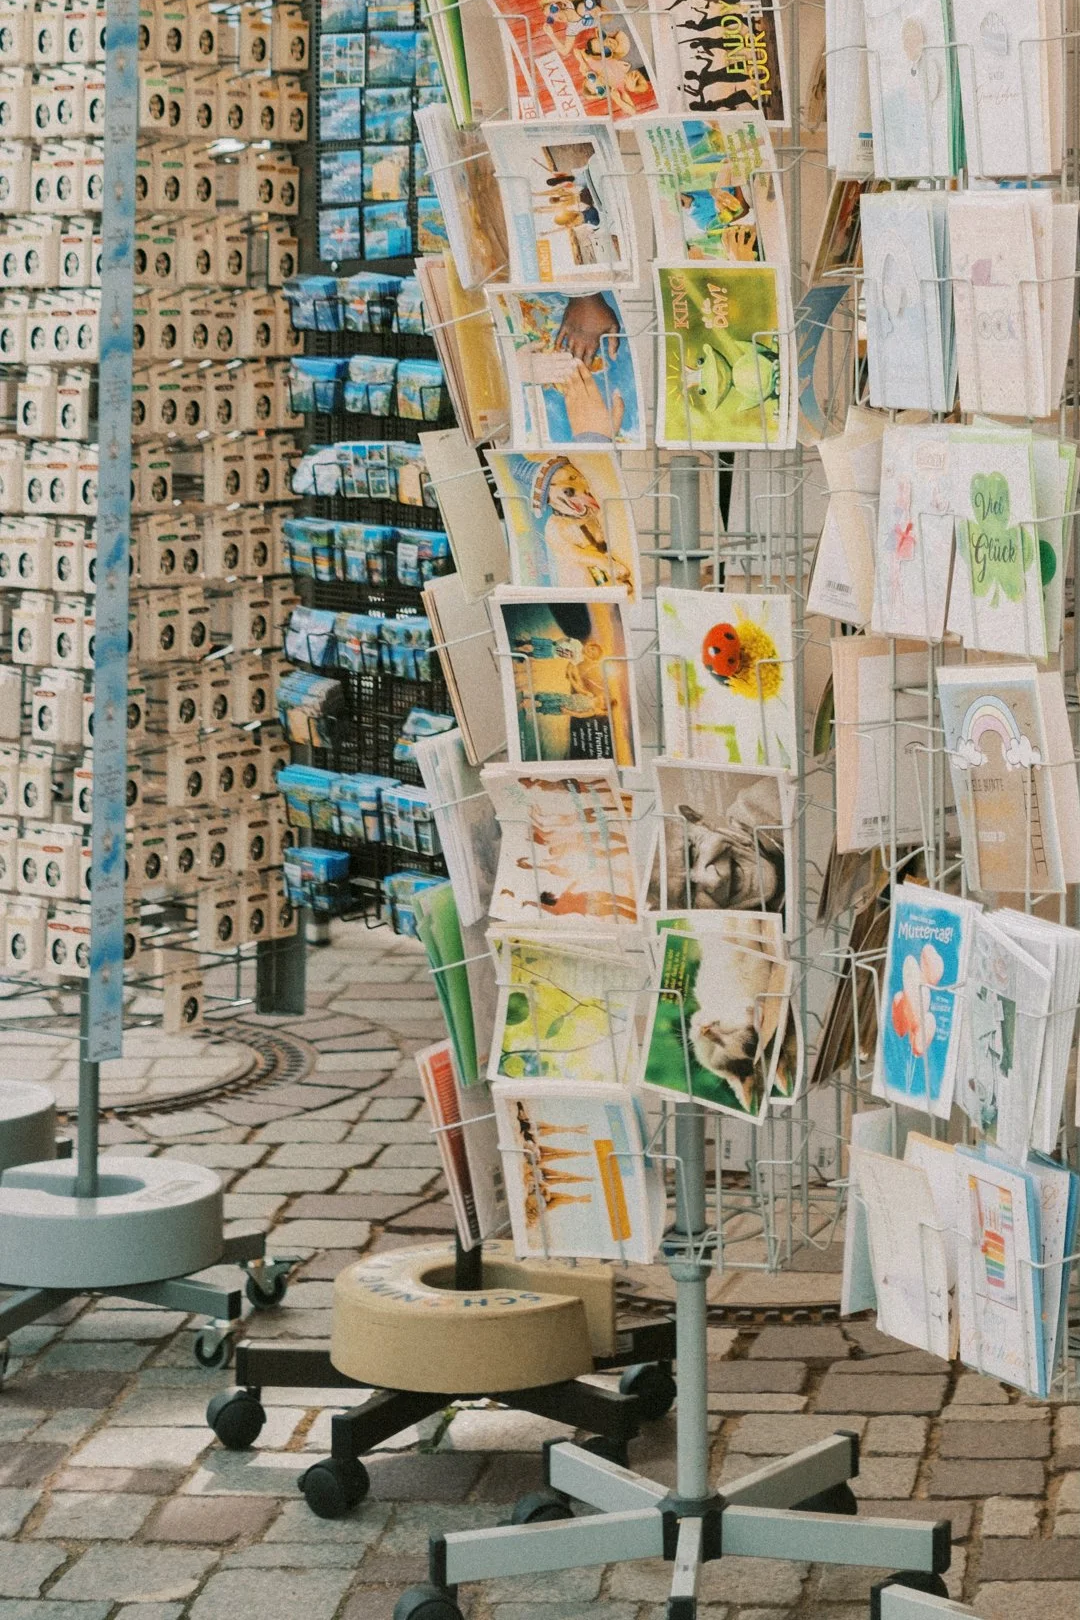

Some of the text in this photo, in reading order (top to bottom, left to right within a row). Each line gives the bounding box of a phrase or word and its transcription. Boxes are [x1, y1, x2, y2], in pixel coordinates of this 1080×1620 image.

[719, 0, 746, 75] ENJOY
[749, 30, 773, 104] YOUR
[668, 275, 690, 329] KING
[707, 282, 729, 329] DAY!
[974, 491, 1004, 521] Viel
[971, 532, 1016, 583] Glück
[897, 921, 954, 945] Muttertag!
